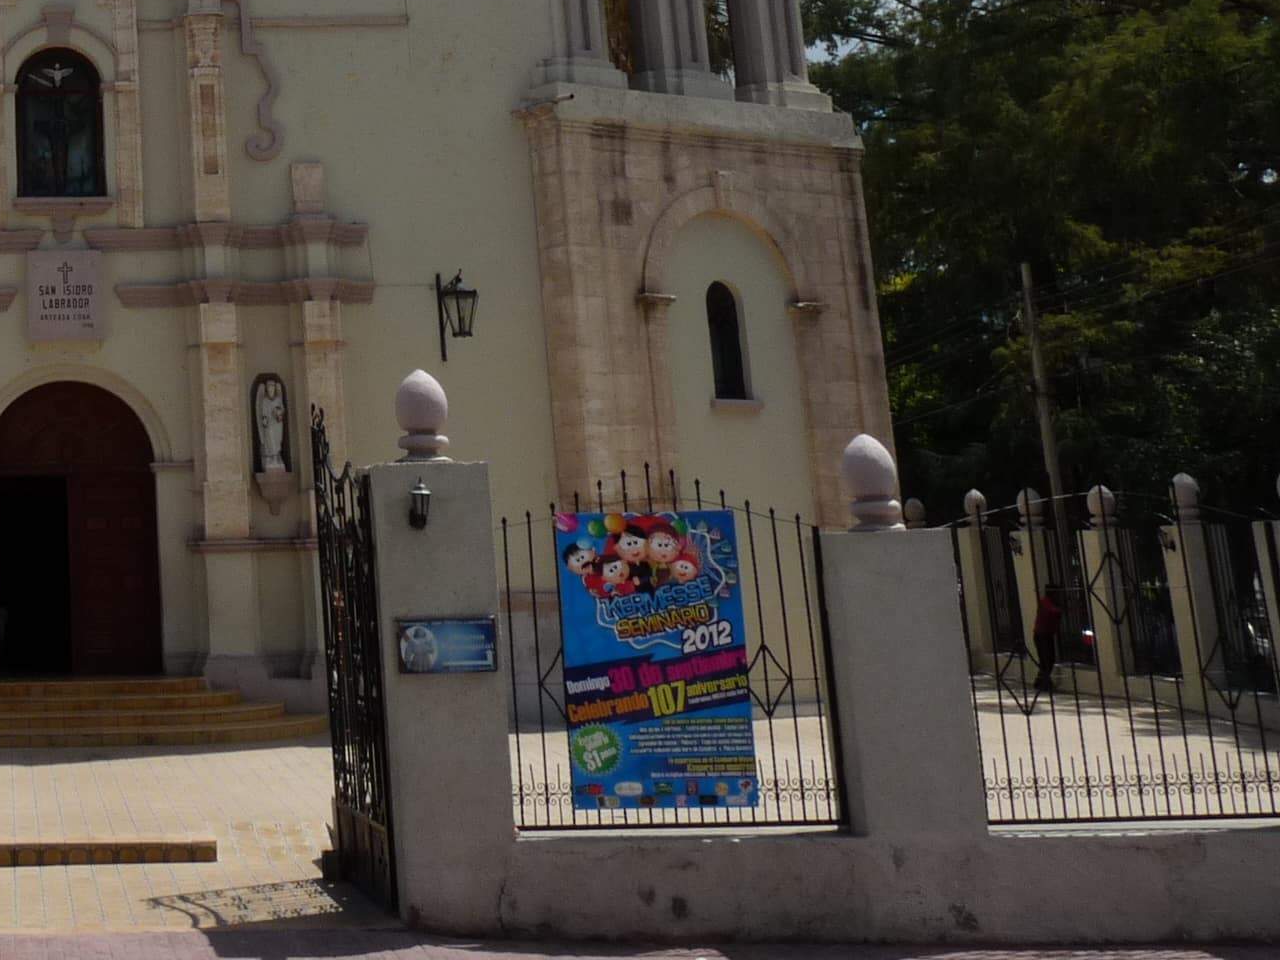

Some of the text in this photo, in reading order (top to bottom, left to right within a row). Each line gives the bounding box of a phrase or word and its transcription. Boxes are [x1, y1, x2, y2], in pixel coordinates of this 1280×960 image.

[38, 284, 93, 296] SAN ISIDRO
[42, 298, 90, 309] LABRADOR
[606, 577, 713, 618] KERMESSE
[616, 604, 710, 637] SEMINARIO
[682, 621, 732, 654] 2012
[566, 676, 610, 695] Domingo
[608, 665, 634, 694] 30
[638, 662, 663, 688] de
[568, 674, 748, 722] Celebrando 107 aniversario
